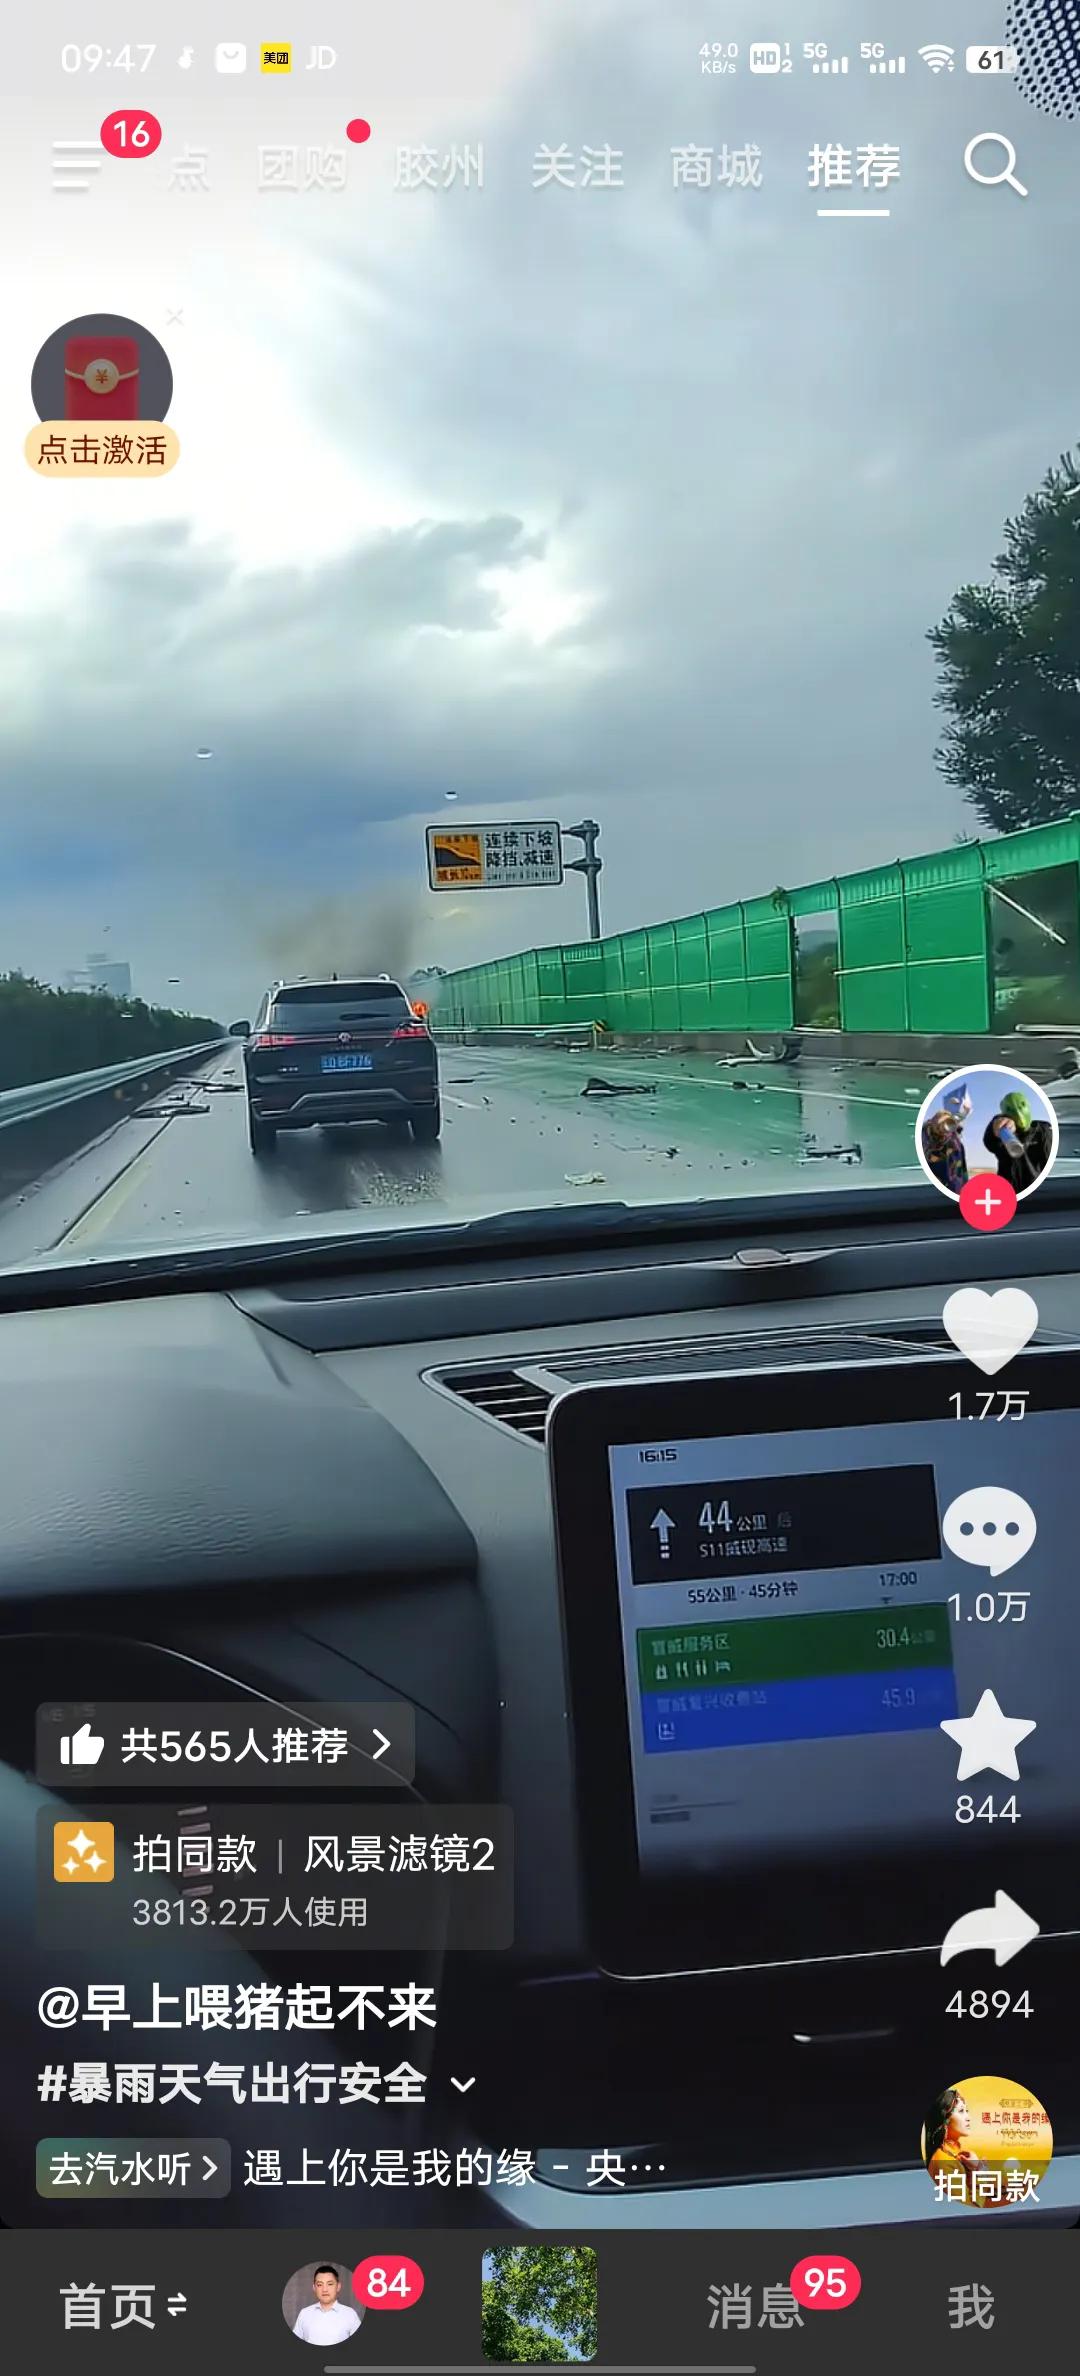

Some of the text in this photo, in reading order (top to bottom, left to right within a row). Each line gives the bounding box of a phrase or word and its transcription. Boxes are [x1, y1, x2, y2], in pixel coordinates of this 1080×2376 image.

[485, 830, 554, 848] 连续下坡
[640, 1448, 677, 1463] 16:15
[879, 1570, 918, 1587] 17:00
[881, 1686, 916, 1709] 459
